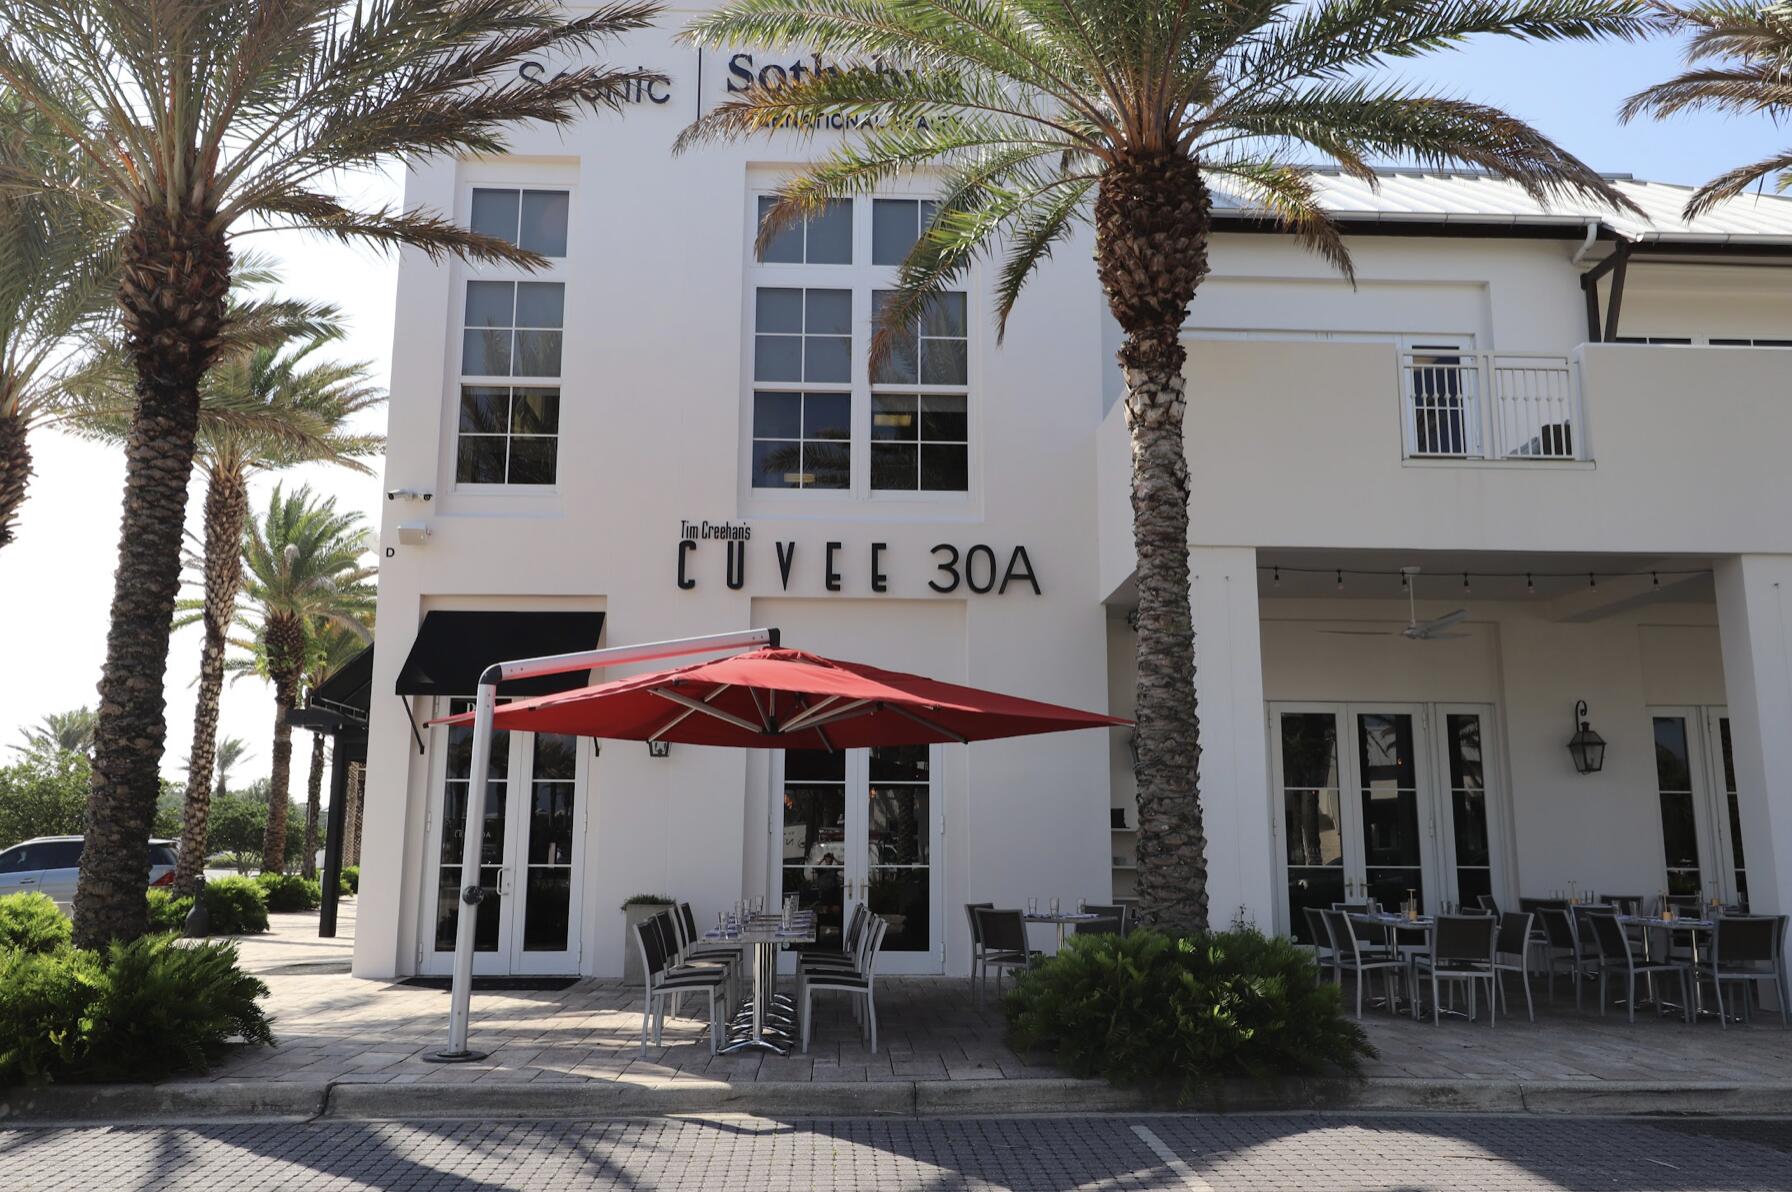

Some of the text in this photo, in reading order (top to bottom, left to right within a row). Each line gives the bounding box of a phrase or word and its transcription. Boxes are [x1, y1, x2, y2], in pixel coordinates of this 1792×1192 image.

[681, 520, 751, 540] Tim Creehan's
[386, 547, 395, 558] D
[677, 540, 1042, 596] CUVEE 30A
